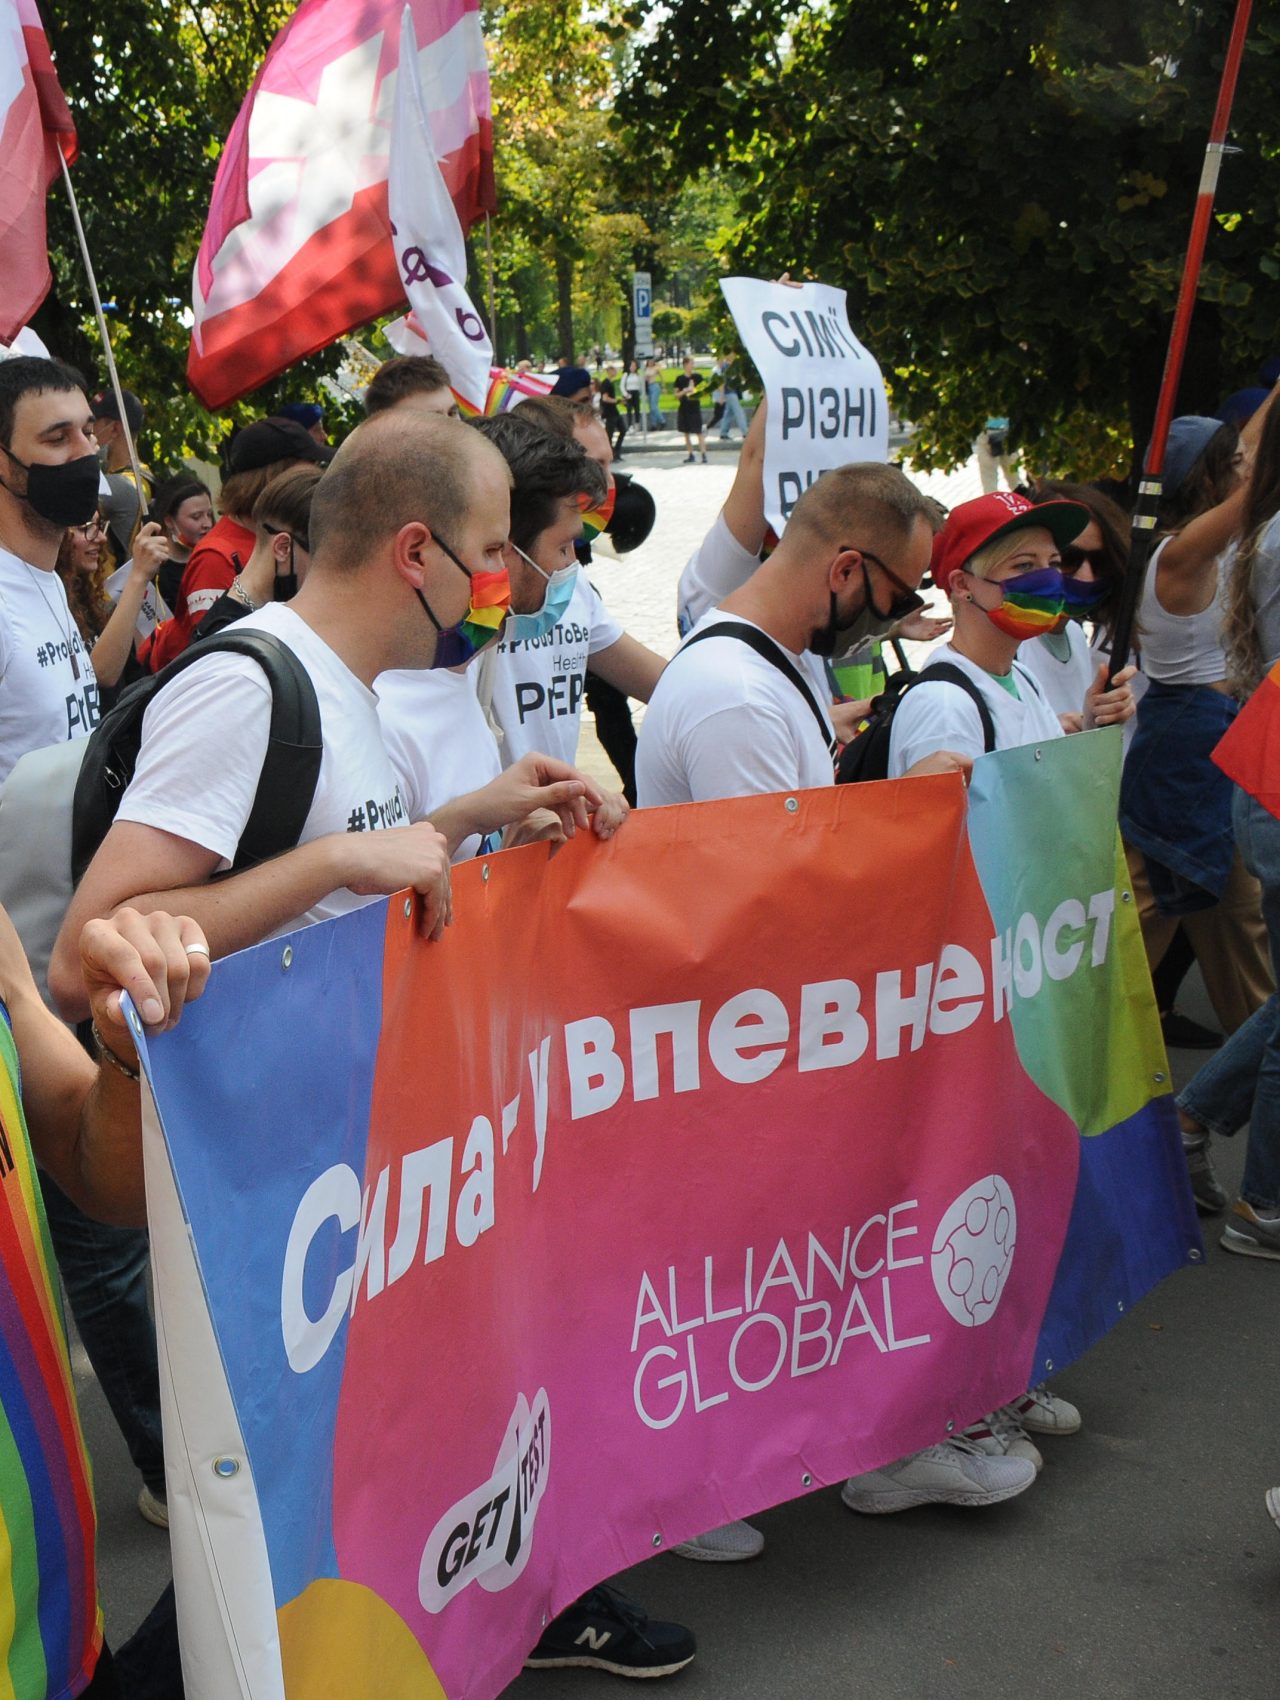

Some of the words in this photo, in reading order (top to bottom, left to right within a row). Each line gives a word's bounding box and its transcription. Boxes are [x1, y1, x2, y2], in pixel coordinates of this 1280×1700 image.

[639, 290, 649, 316] P
[781, 387, 876, 440] РІЗНІ
[281, 1116, 495, 1374] Сила
[630, 1200, 924, 1353] ALLIANCE
[633, 1277, 931, 1430] GLOBAL
[521, 1406, 546, 1516] TEST
[437, 1485, 511, 1588] GET
[574, 1626, 612, 1650] N
